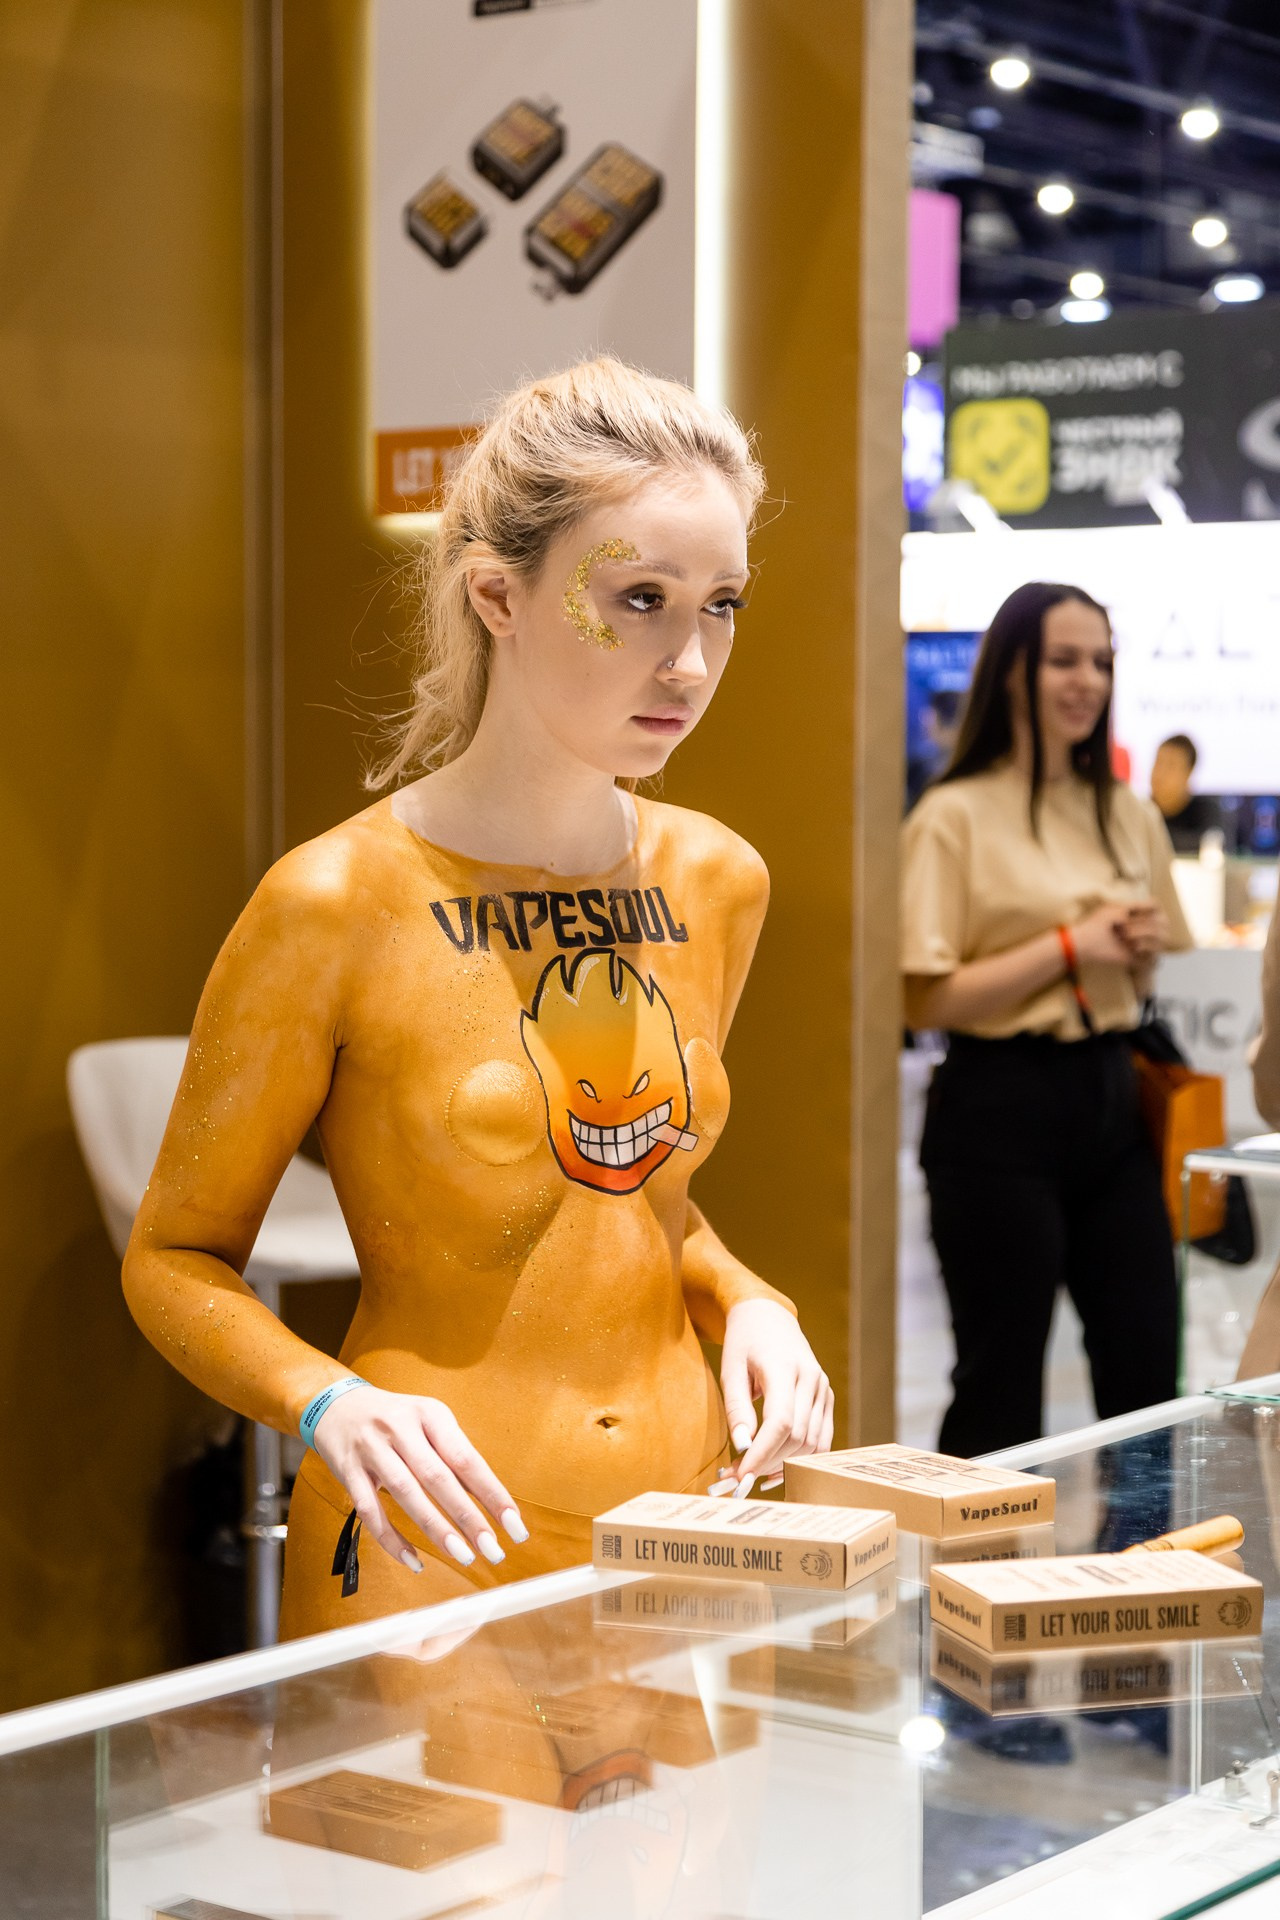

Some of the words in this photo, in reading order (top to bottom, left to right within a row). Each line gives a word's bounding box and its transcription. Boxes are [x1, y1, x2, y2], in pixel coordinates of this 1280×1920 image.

[429, 886, 689, 954] VAPESOUL
[960, 1498, 1038, 1521] VapeSoul
[602, 1534, 614, 1558] 3000
[635, 1539, 657, 1560] LET
[663, 1541, 698, 1564] YOUR
[703, 1544, 738, 1568] SOUL
[743, 1548, 783, 1572] SMILE
[854, 1536, 889, 1567] VapeSoul
[937, 1591, 981, 1628] VapeSoul
[1041, 1613, 1066, 1637] LET
[1071, 1610, 1110, 1635] YOUR
[1115, 1607, 1152, 1632] SOUL
[1157, 1604, 1200, 1629] SMILE
